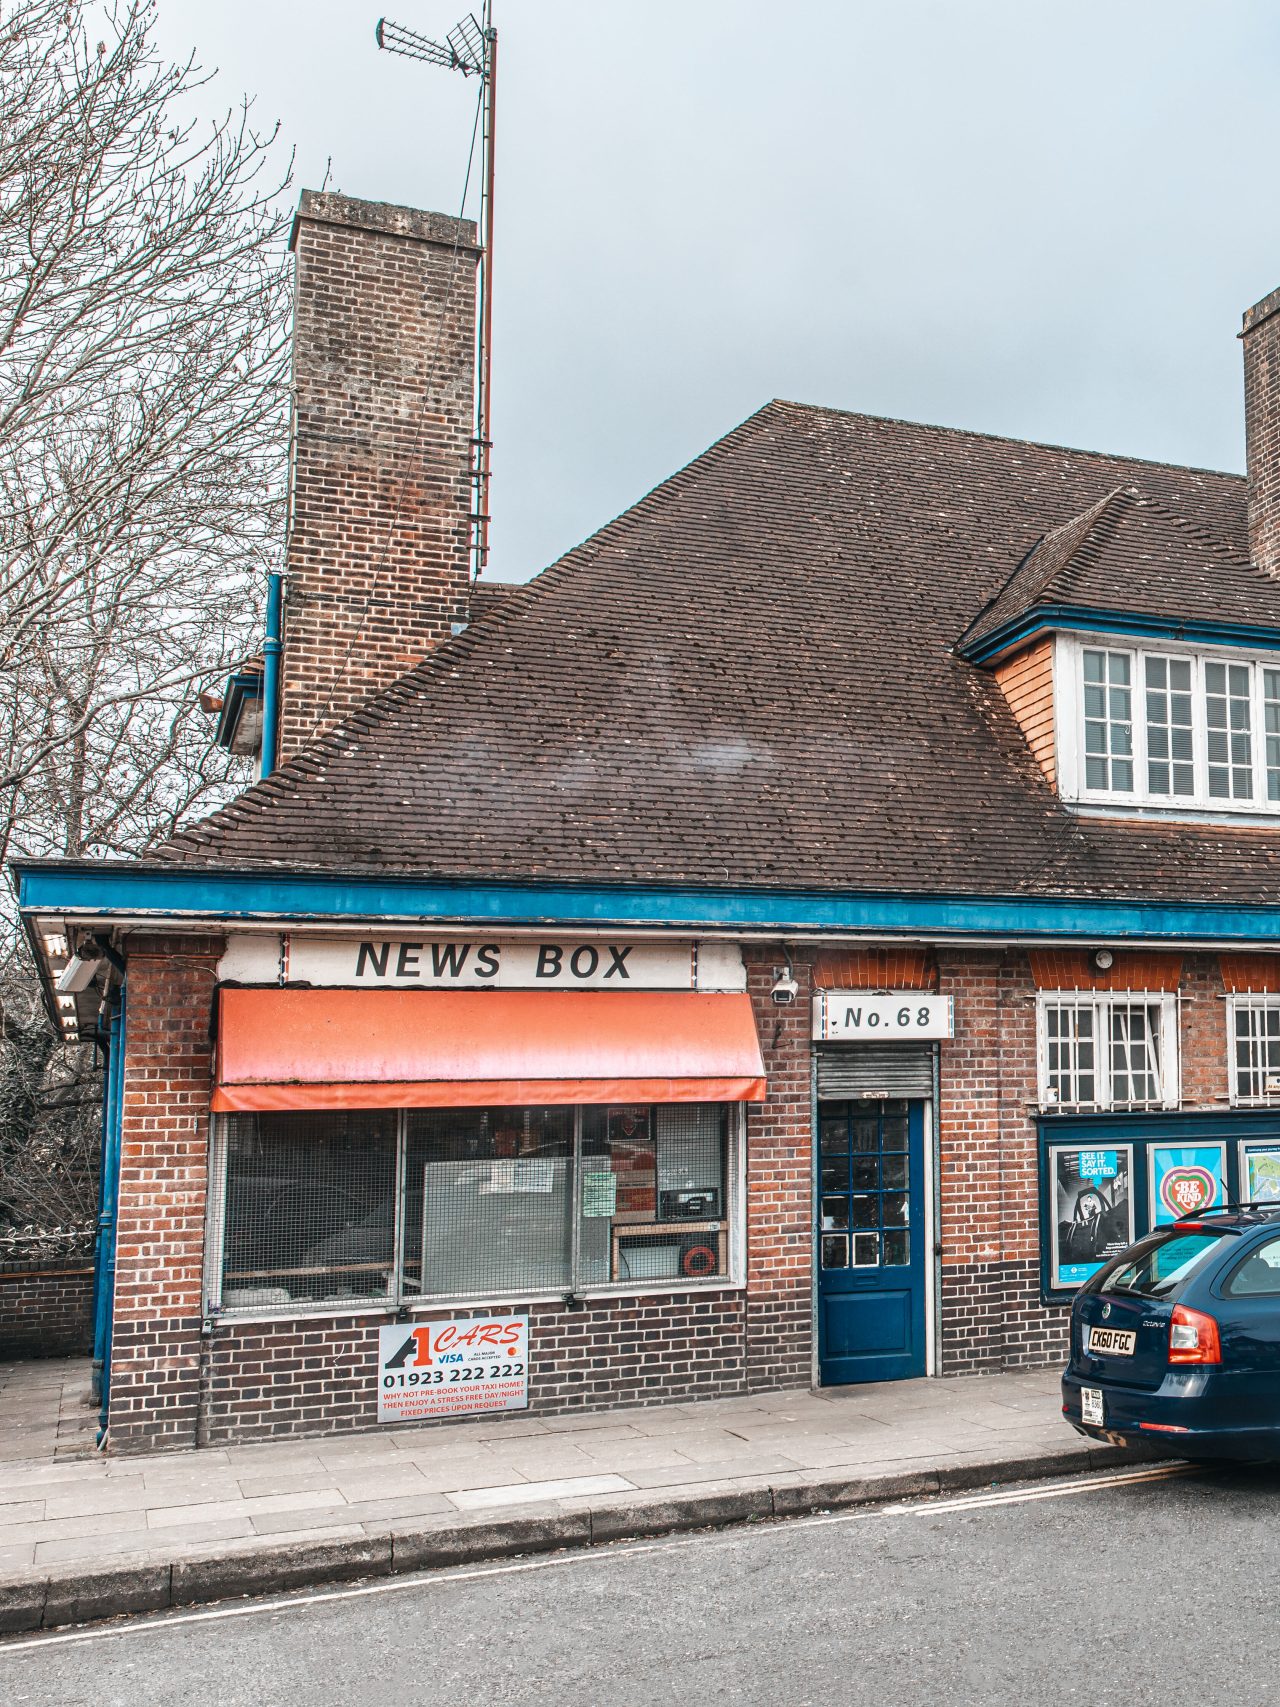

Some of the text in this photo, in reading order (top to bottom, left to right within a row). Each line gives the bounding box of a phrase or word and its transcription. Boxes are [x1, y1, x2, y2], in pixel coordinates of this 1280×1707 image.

[355, 942, 634, 979] NEWS BOX
[1097, 1152, 1106, 1160] IT.
[1082, 1167, 1116, 1176] SORTED.
[1175, 1181, 1199, 1192] BE
[1177, 1192, 1201, 1207] KIND
[385, 1323, 523, 1369] A1 CARS
[1092, 1331, 1131, 1350] CK60 FGC
[438, 1353, 463, 1364] VISA
[384, 1364, 524, 1388] 01923 222 222
[420, 1388, 458, 1396] PRE-BOOK
[405, 1399, 428, 1408] ENJOY
[485, 1390, 524, 1399] DAY/NIGHT
[474, 1400, 507, 1408] REQUEST
